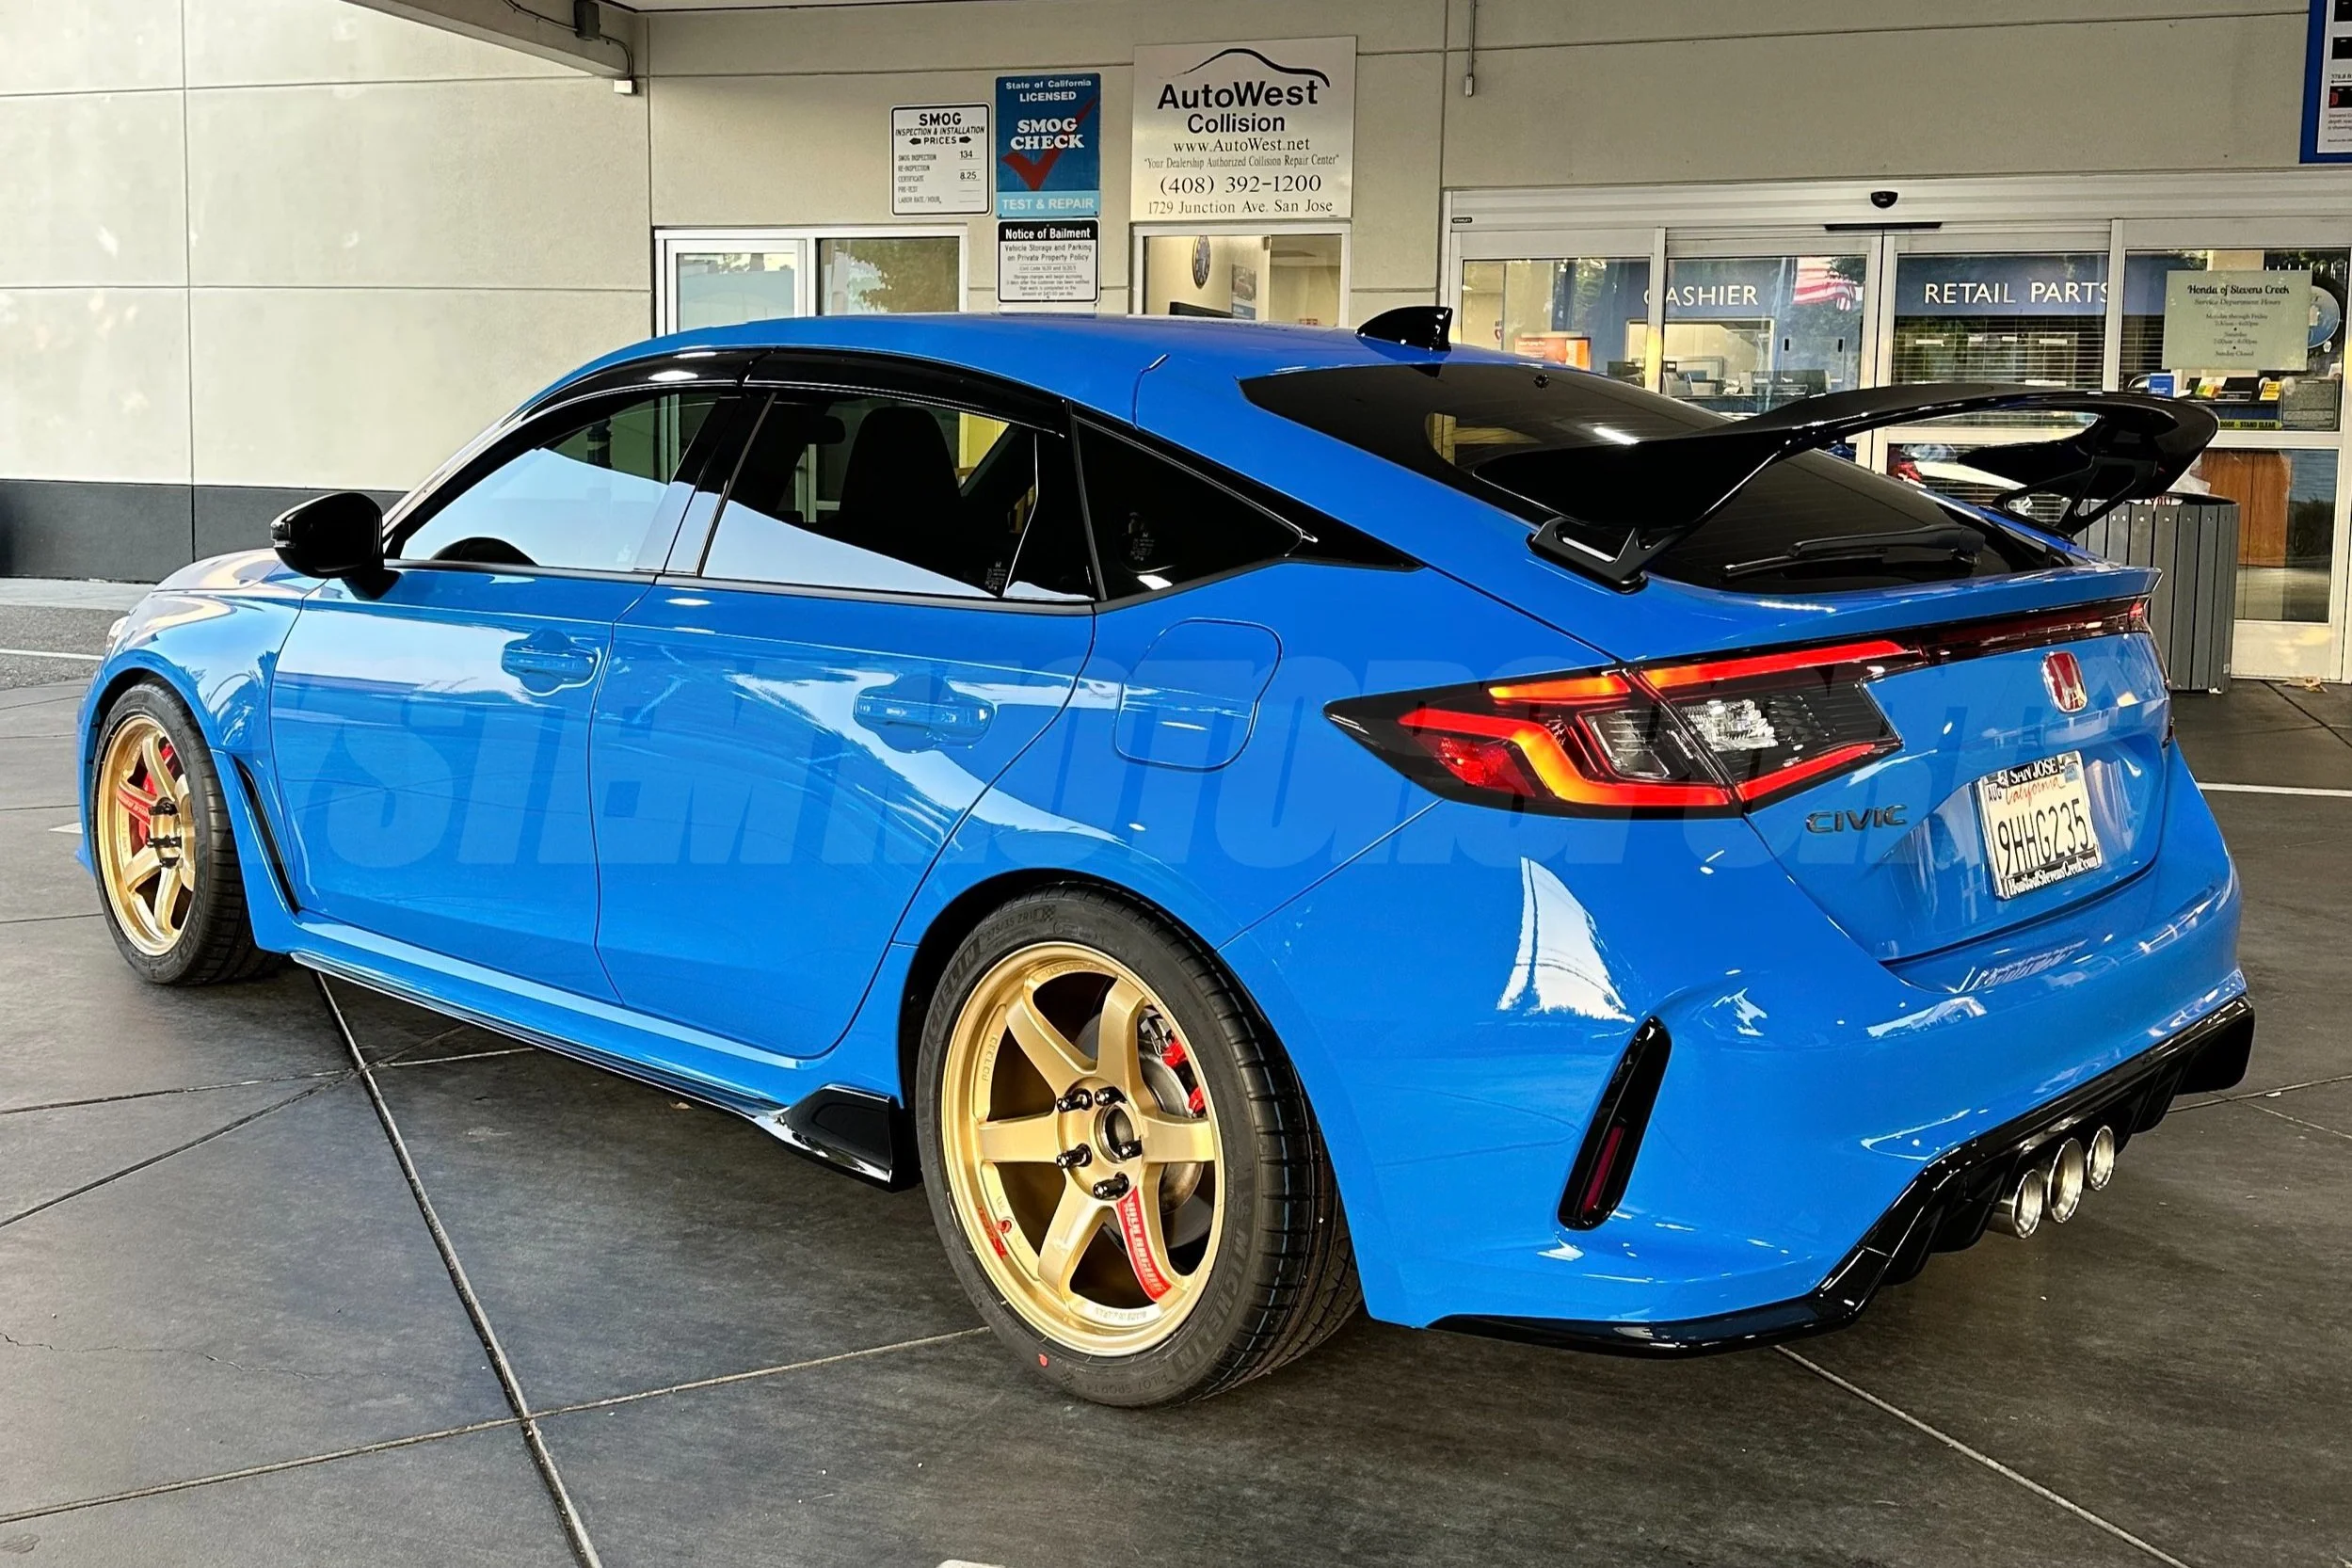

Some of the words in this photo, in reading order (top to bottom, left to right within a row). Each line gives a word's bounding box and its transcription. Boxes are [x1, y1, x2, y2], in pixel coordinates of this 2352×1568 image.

[1048, 79, 1092, 88] California
[1019, 91, 1077, 103] LICENSED
[1157, 80, 1319, 109] AutoWest
[919, 112, 962, 126] SMOG
[1016, 118, 1078, 134] SMOG
[1188, 113, 1285, 134] Collision
[895, 127, 931, 136] INSPECTION
[933, 127, 937, 136] &
[939, 126, 985, 135] INSTALLATION
[923, 136, 957, 145] PRICES
[1010, 134, 1085, 151] CHECK
[1174, 137, 1310, 152] www.AutoWest.net
[960, 151, 973, 159] 134
[1166, 157, 1205, 169] Dealership
[1207, 156, 1246, 168] Authorized
[1249, 155, 1282, 167] Collision
[1284, 154, 1308, 168] Repair
[960, 171, 977, 180] 8.25
[1160, 175, 1215, 196] (408)
[1225, 174, 1322, 194] 392-1200
[1001, 199, 1032, 210] TEST
[1036, 199, 1045, 210] &
[1048, 198, 1095, 209] REPAIR
[1148, 201, 1174, 214] 1729
[1178, 200, 1236, 215] Junction
[1241, 200, 1269, 213] Ave.
[1274, 200, 1299, 213] San
[1305, 199, 1333, 213] Jose
[1005, 228, 1034, 239] Notice
[1037, 228, 1048, 239] of
[1049, 227, 1091, 239] Bailment
[1029, 244, 1052, 252] Storage
[1067, 244, 1092, 252] Parking
[1017, 253, 1039, 262] Private
[1041, 253, 1067, 262] Property
[1069, 252, 1089, 262] Policy
[1924, 283, 2016, 304] RETAIL
[2030, 281, 2108, 304] PARTS
[2187, 284, 2217, 295] Honda
[2220, 284, 2229, 296] of
[2230, 284, 2263, 295] Stevens
[2265, 284, 2290, 295] Creek
[2010, 765, 2034, 784] SAN
[2033, 758, 2058, 778] JOSE
[1988, 783, 2003, 802] AUG
[2005, 777, 2066, 807] California
[1805, 805, 1908, 833] CIVIC
[1997, 798, 2089, 876] 9HHG235
